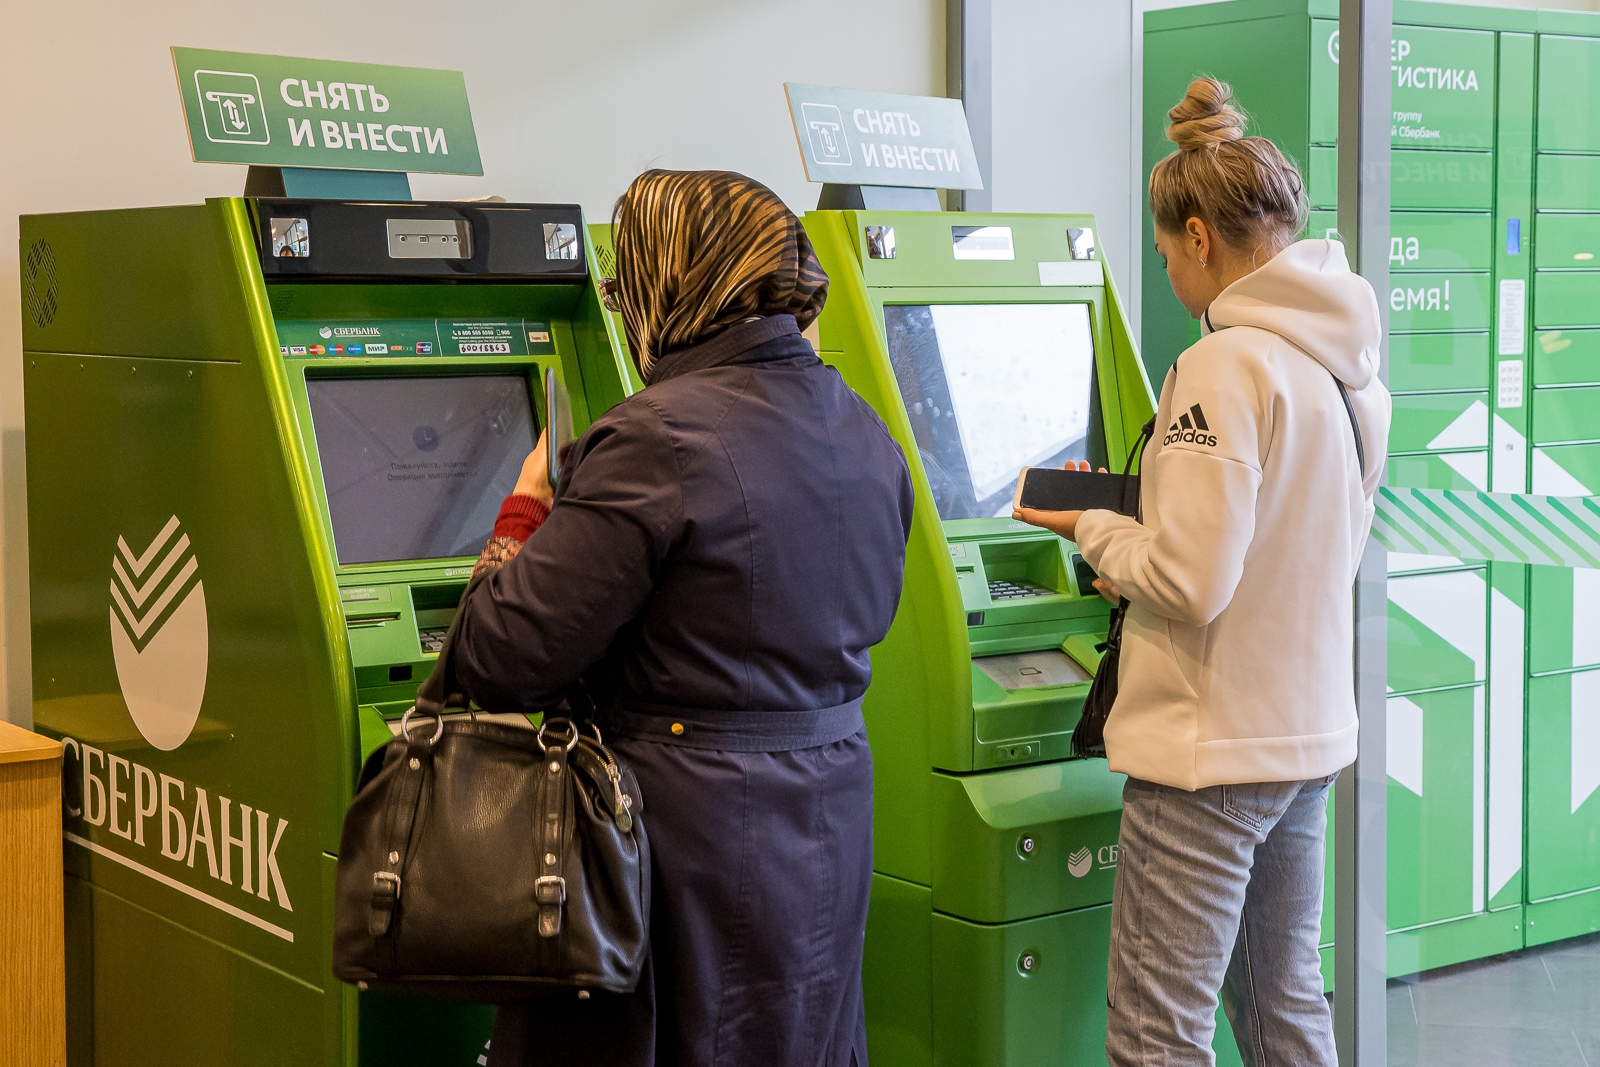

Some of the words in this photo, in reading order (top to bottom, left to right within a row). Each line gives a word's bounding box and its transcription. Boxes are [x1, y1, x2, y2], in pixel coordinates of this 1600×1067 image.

[279, 78, 390, 113] СНЯТЬ
[853, 108, 921, 137] СНЯТЬ
[1393, 110, 1423, 123] группу
[287, 117, 316, 148] И
[320, 119, 449, 155] ВНЕСТИ
[1399, 125, 1440, 139] Сбербанк
[860, 142, 880, 168] И
[880, 143, 961, 173] ВНЕСТИ
[1389, 236, 1419, 265] да
[1390, 279, 1450, 311] емя!
[333, 327, 380, 335] СБЕРБАНК
[1163, 429, 1218, 447] adidas
[387, 473, 426, 481] Операция
[428, 471, 478, 479] выполняется
[391, 461, 441, 470] Пожалуйста,
[62, 737, 294, 912] СБЕРБАНК
[1098, 844, 1119, 865] СБ
